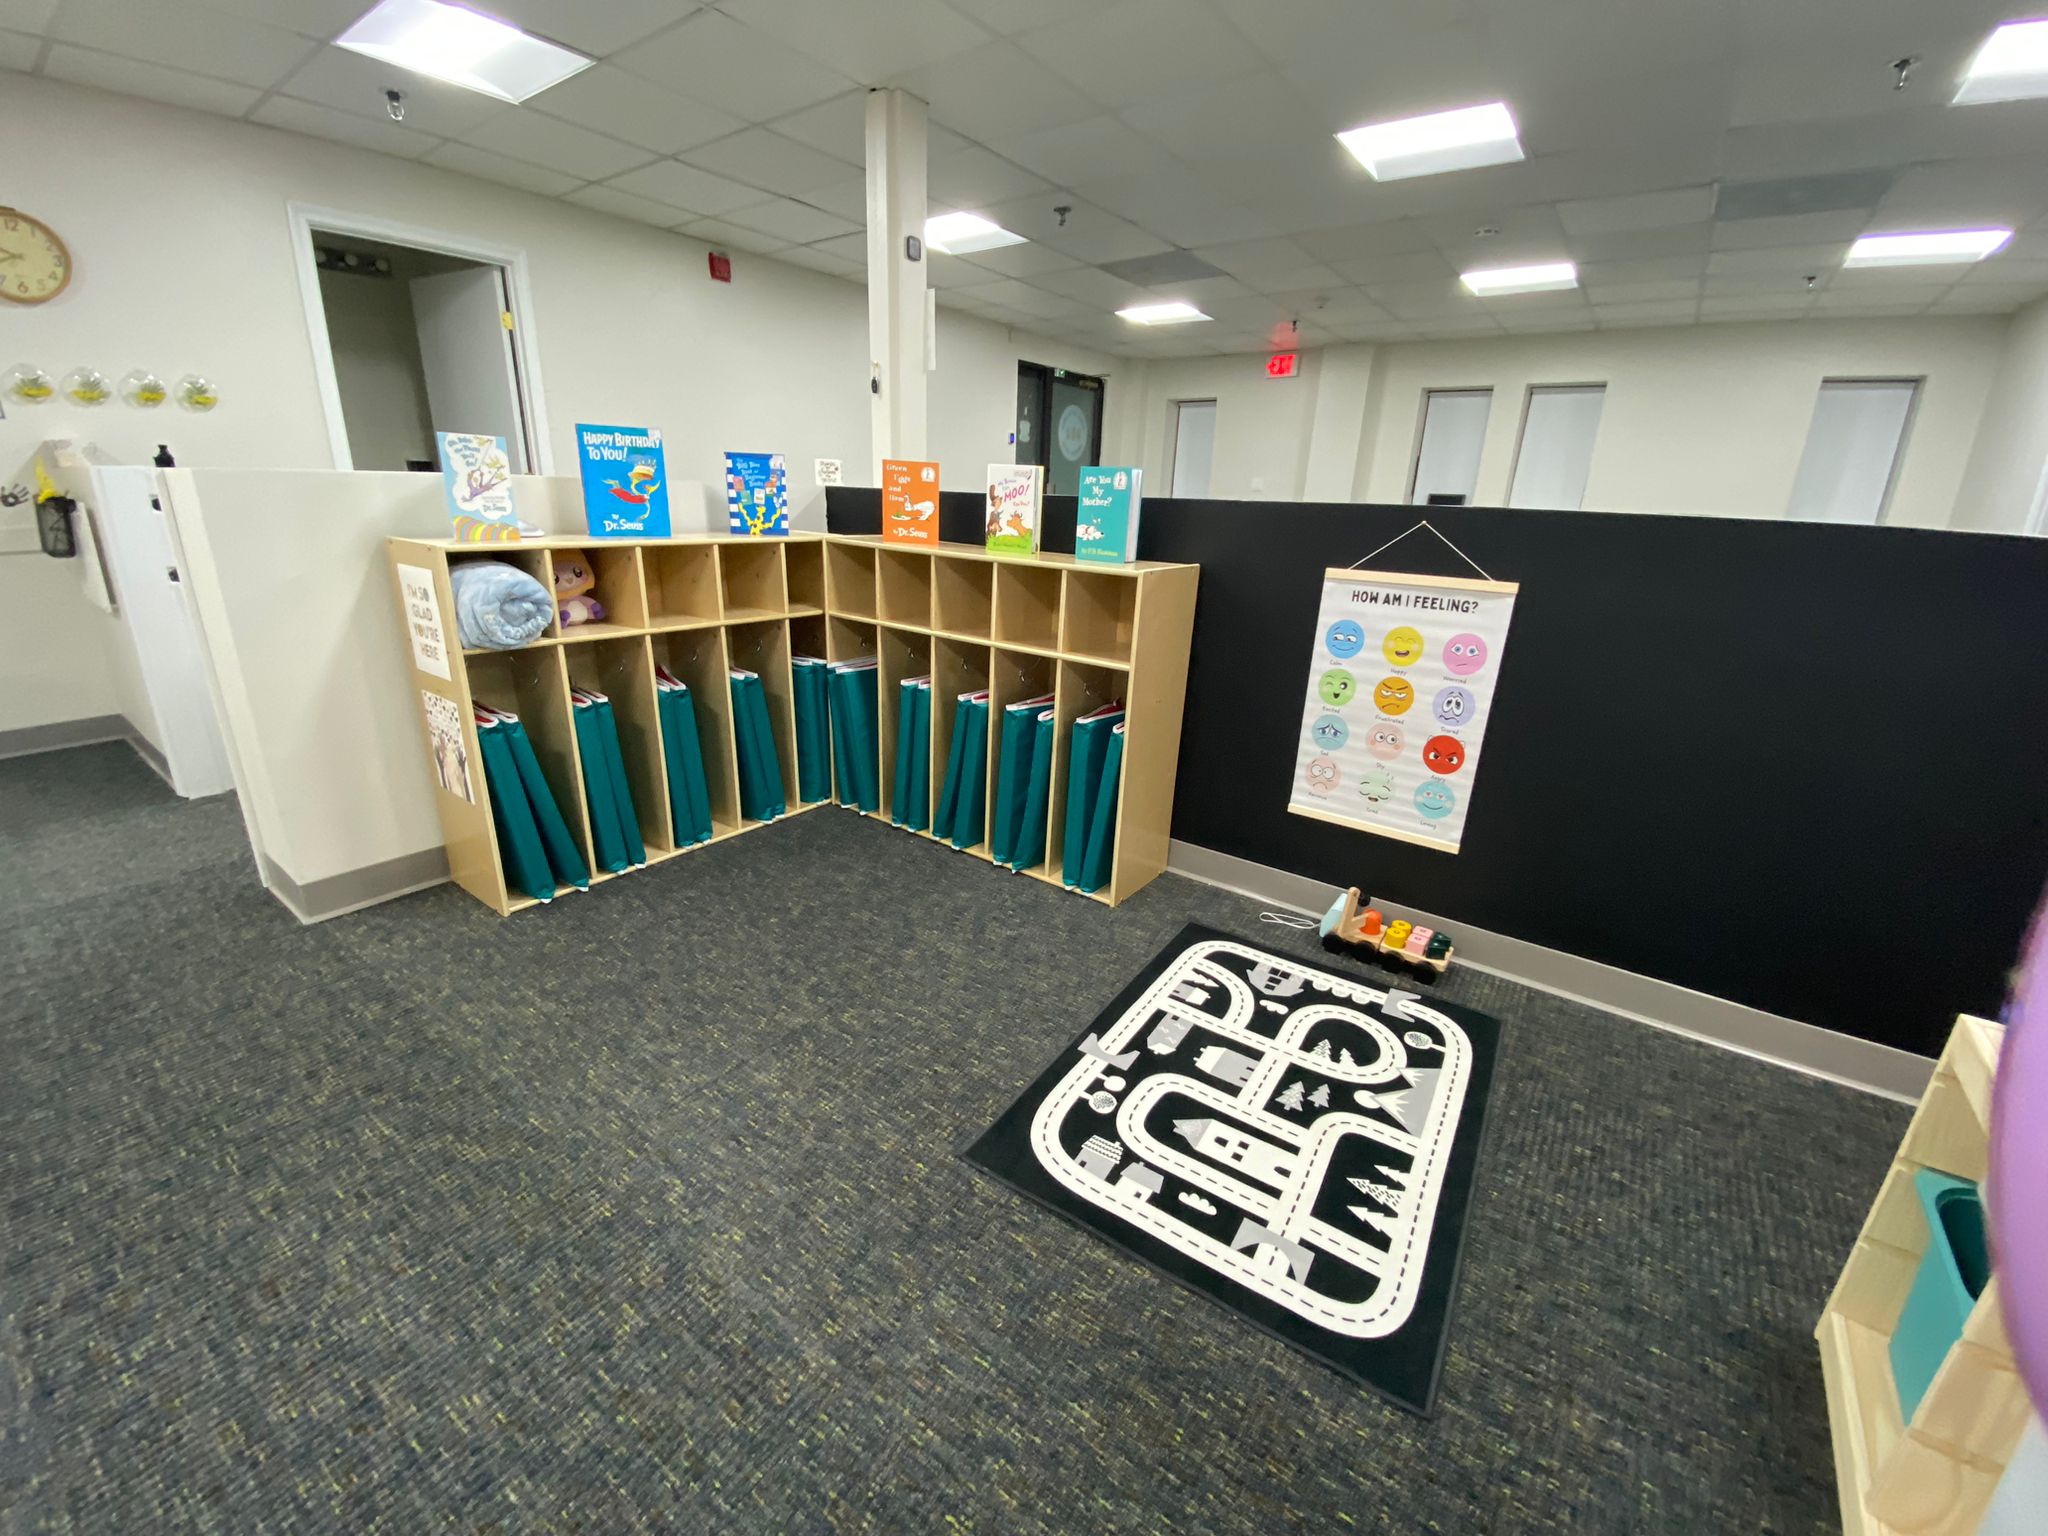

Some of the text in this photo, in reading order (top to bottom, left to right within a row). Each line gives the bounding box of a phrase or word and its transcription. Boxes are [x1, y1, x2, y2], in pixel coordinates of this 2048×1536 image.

[53, 254, 64, 268] 3
[48, 269, 58, 281] 4
[17, 281, 29, 295] 6
[583, 431, 660, 449] HAPPY BIRTHDAY
[586, 446, 628, 462] TO YOU!
[886, 464, 907, 472] Green
[1084, 475, 1112, 485] Are You
[1004, 483, 1030, 502] MOO!
[1092, 485, 1105, 497] My
[1082, 496, 1112, 508] Mother?
[603, 519, 644, 532] Dr. Seuss
[1352, 590, 1479, 614] HOW AM I FEELING?
[411, 603, 433, 622] GLAD
